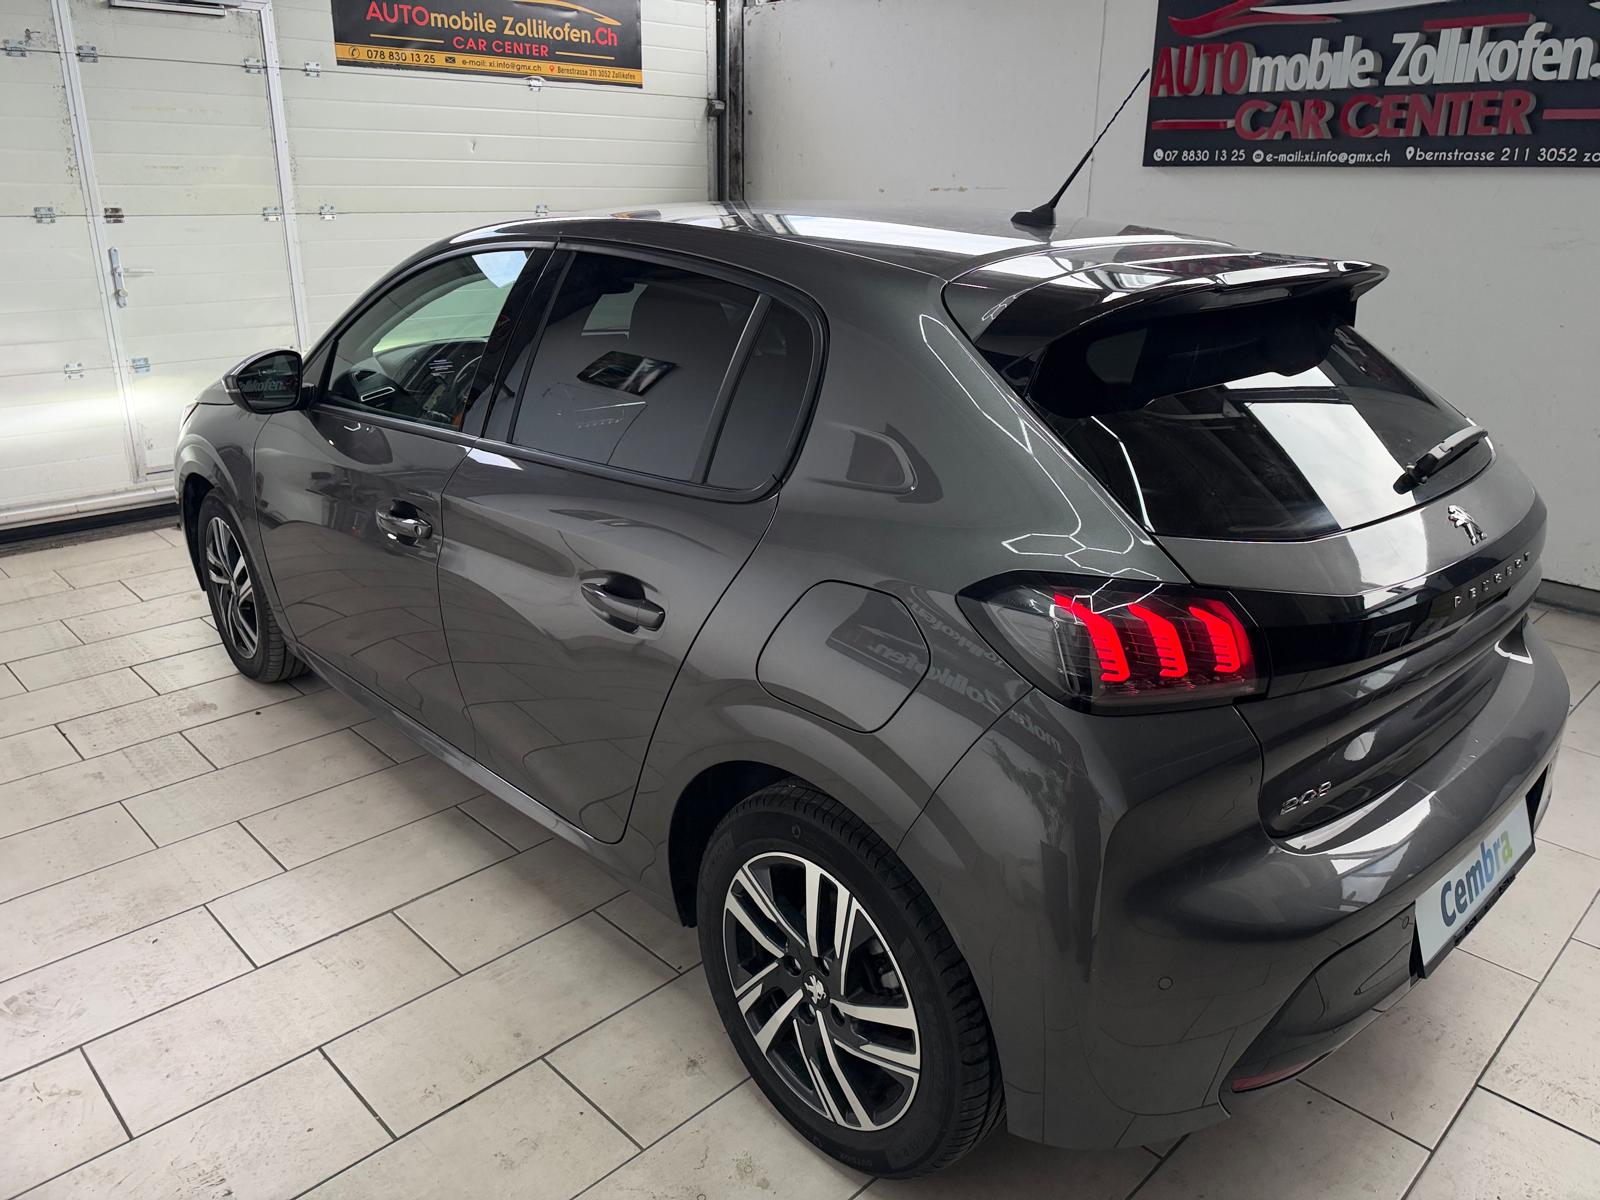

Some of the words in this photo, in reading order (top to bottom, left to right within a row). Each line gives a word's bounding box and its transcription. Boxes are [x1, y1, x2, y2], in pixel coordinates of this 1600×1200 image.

[366, 1, 497, 33] AUTOmobile
[502, 15, 619, 46] Zollikofen.Ch
[366, 49, 386, 60] 078
[388, 51, 407, 62] 830
[410, 52, 421, 63] 13
[423, 54, 436, 64] 25
[461, 59, 486, 68] e-mail:
[452, 36, 487, 51] CAR
[492, 40, 549, 57] CENTER
[1151, 35, 1380, 97] AUTOmobile
[1384, 22, 1600, 86] Zollikofen.
[1235, 98, 1334, 140] CAR
[1340, 89, 1534, 138] CENTER
[1164, 150, 1179, 162] 07
[1181, 150, 1210, 162] 8830
[1214, 150, 1227, 161] 13
[1230, 149, 1246, 161] 25
[1415, 148, 1495, 162] bernstrasse
[1500, 147, 1530, 161] 211
[1537, 148, 1578, 162] 3052
[1280, 781, 1332, 816] 208
[1440, 830, 1513, 928] Cembra
